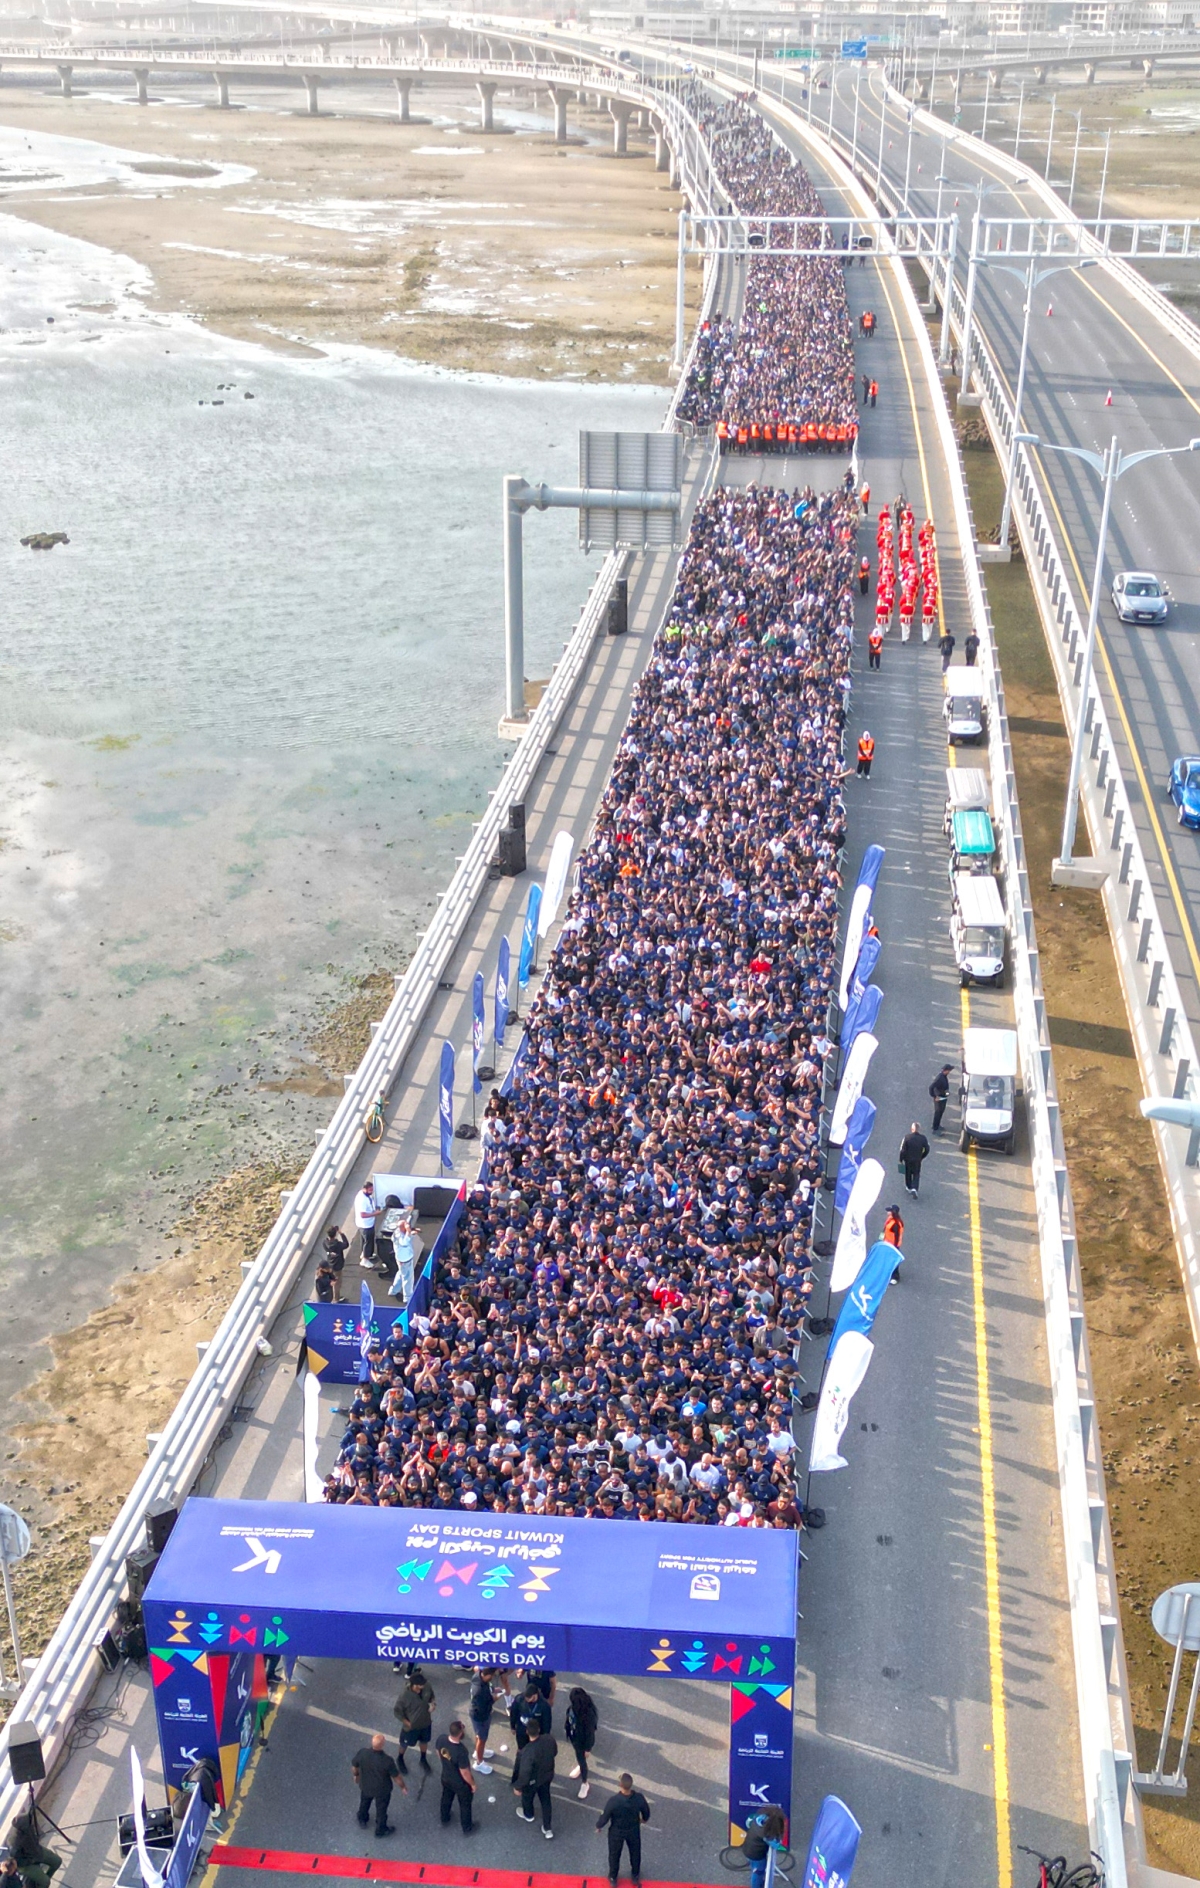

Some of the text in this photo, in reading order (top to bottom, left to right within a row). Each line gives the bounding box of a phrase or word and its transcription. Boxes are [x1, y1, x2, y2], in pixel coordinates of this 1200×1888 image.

[409, 1523, 564, 1544] KUWAIT SPORTS DAY
[406, 1536, 562, 1561] يوم الكويت الرياضي
[375, 1622, 546, 1649] يوم الكويت الرياضي
[377, 1645, 546, 1666] KUWAIT SPORTS DAY
